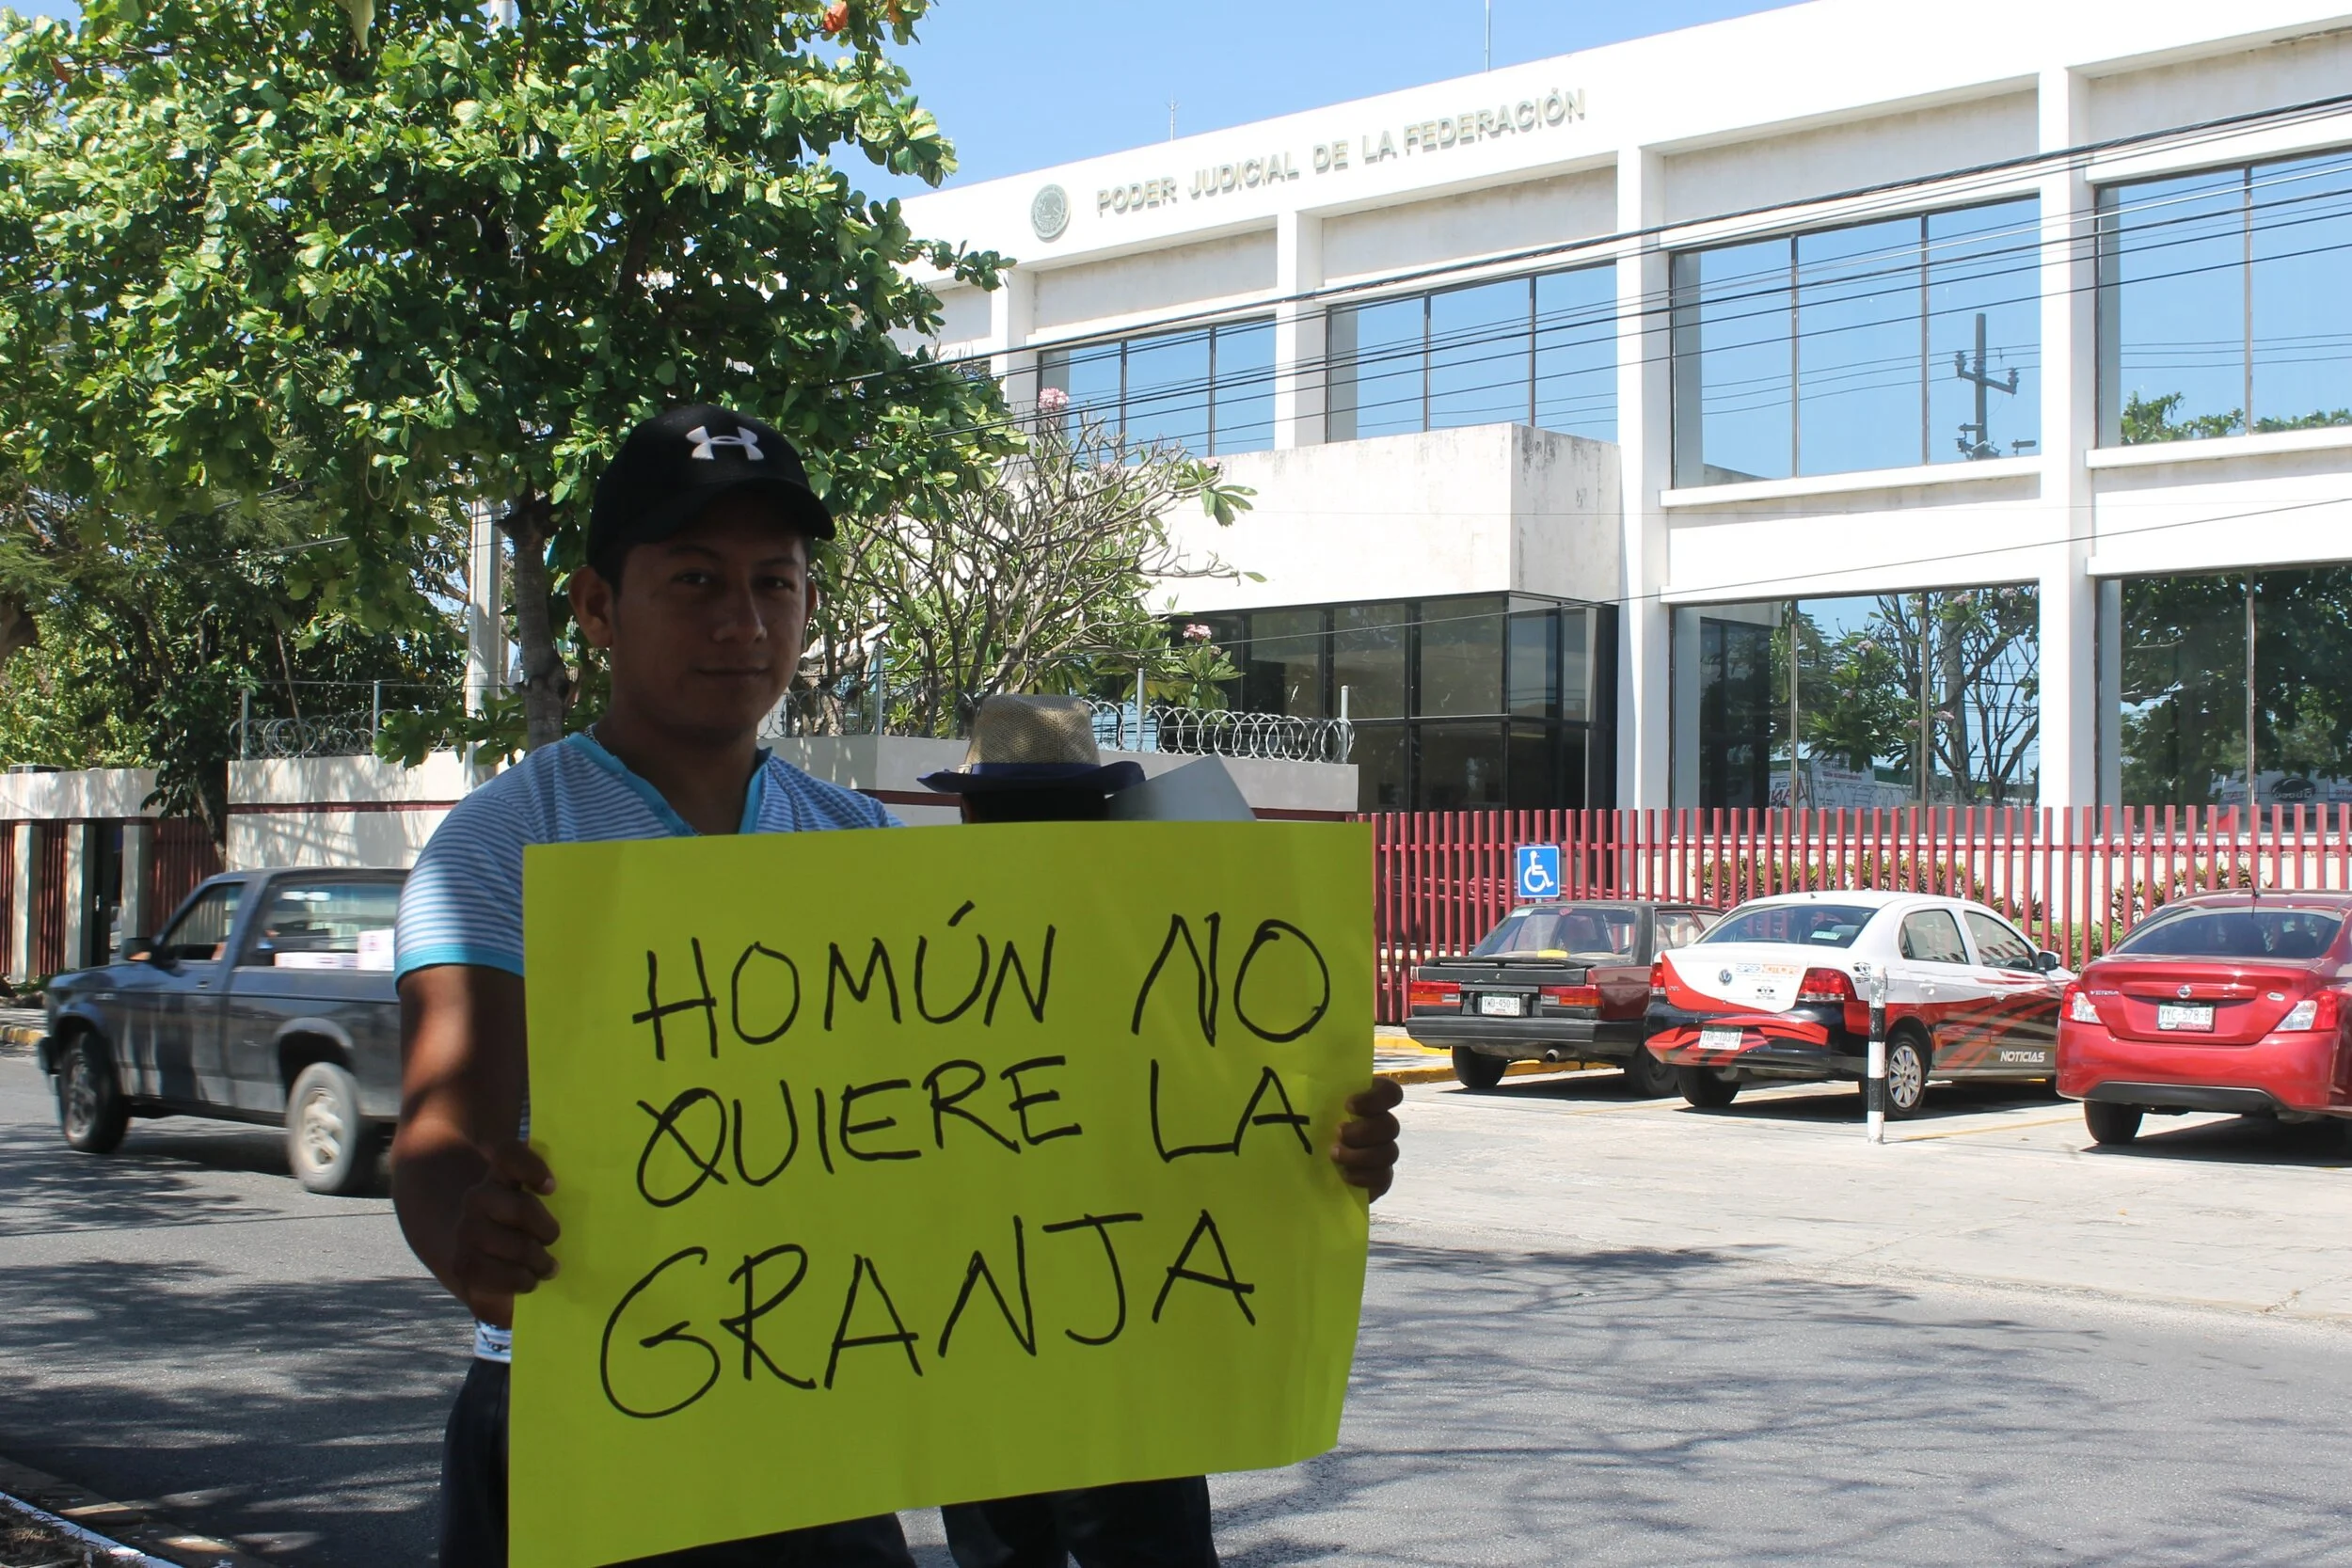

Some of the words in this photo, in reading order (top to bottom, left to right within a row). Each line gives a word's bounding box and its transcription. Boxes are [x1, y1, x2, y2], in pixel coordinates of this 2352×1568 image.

[1097, 177, 1177, 215] PODER
[1189, 151, 1299, 198] JUDICIAL
[1313, 140, 1348, 172] DE
[1362, 130, 1396, 162] LA
[1404, 87, 1585, 152] FEDERACIÓN
[630, 900, 1057, 1061] HOMÚN
[1131, 911, 1331, 1047] NO
[2000, 1050, 2046, 1063] NOTICIAS
[636, 1055, 1083, 1208] QUIERE
[1150, 1059, 1313, 1164] LA
[599, 1209, 1256, 1418] GRANJA
